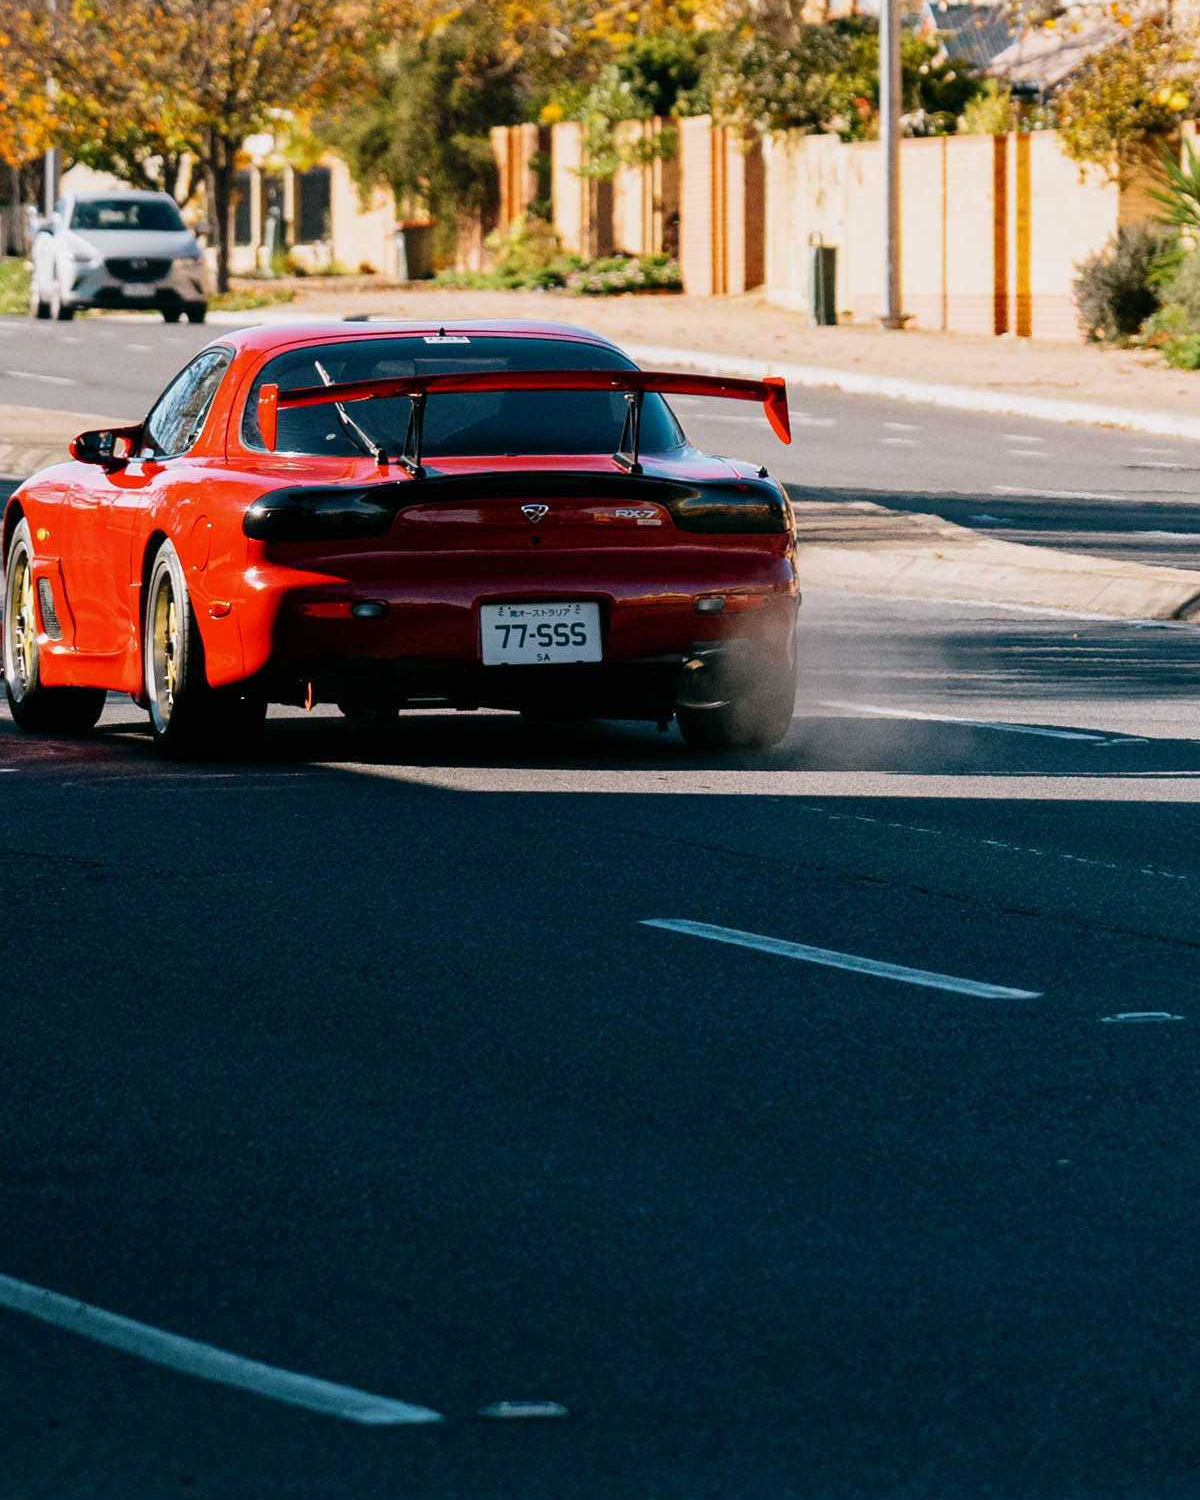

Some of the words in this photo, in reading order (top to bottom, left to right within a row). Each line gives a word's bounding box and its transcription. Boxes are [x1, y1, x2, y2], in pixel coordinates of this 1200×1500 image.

[615, 509, 657, 518] RX-7
[495, 622, 587, 649] 77-SSS
[536, 653, 551, 662] SA
